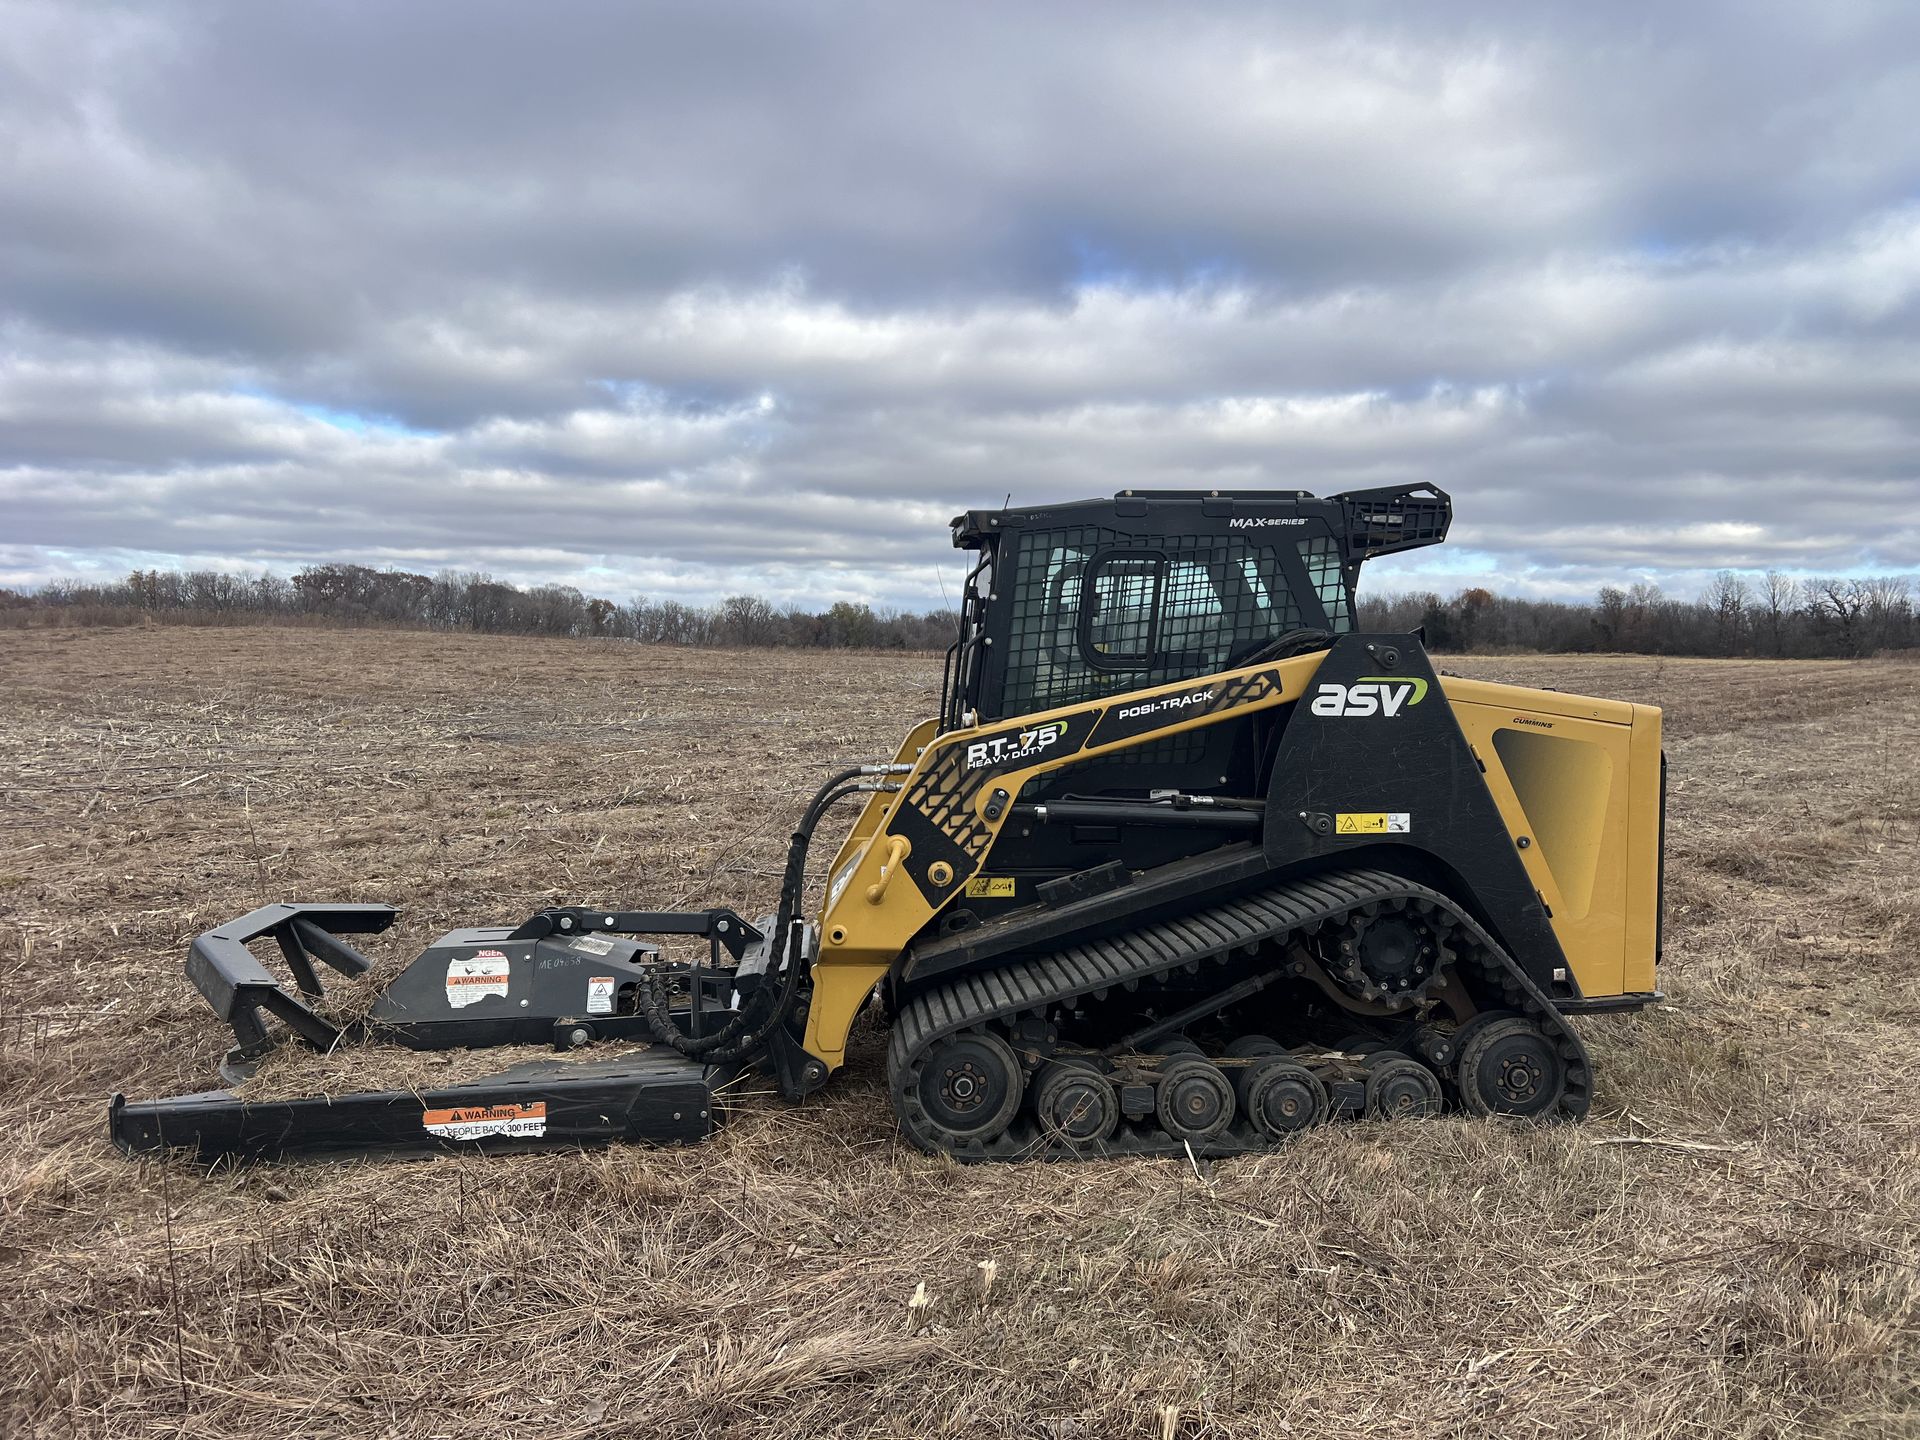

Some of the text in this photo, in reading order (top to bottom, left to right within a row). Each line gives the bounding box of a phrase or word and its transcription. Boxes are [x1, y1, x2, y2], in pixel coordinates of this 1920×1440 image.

[1118, 689, 1214, 720] POSI-TRACK
[1512, 717, 1553, 728] CUMMINS
[967, 725, 1057, 763] RT-75
[967, 744, 1046, 770] HEAVY DUTY
[461, 976, 502, 985] WARNING
[464, 1108, 516, 1120] WARNING
[482, 1124, 506, 1134] BACK
[507, 1123, 522, 1133] 300
[523, 1122, 544, 1132] FEET
